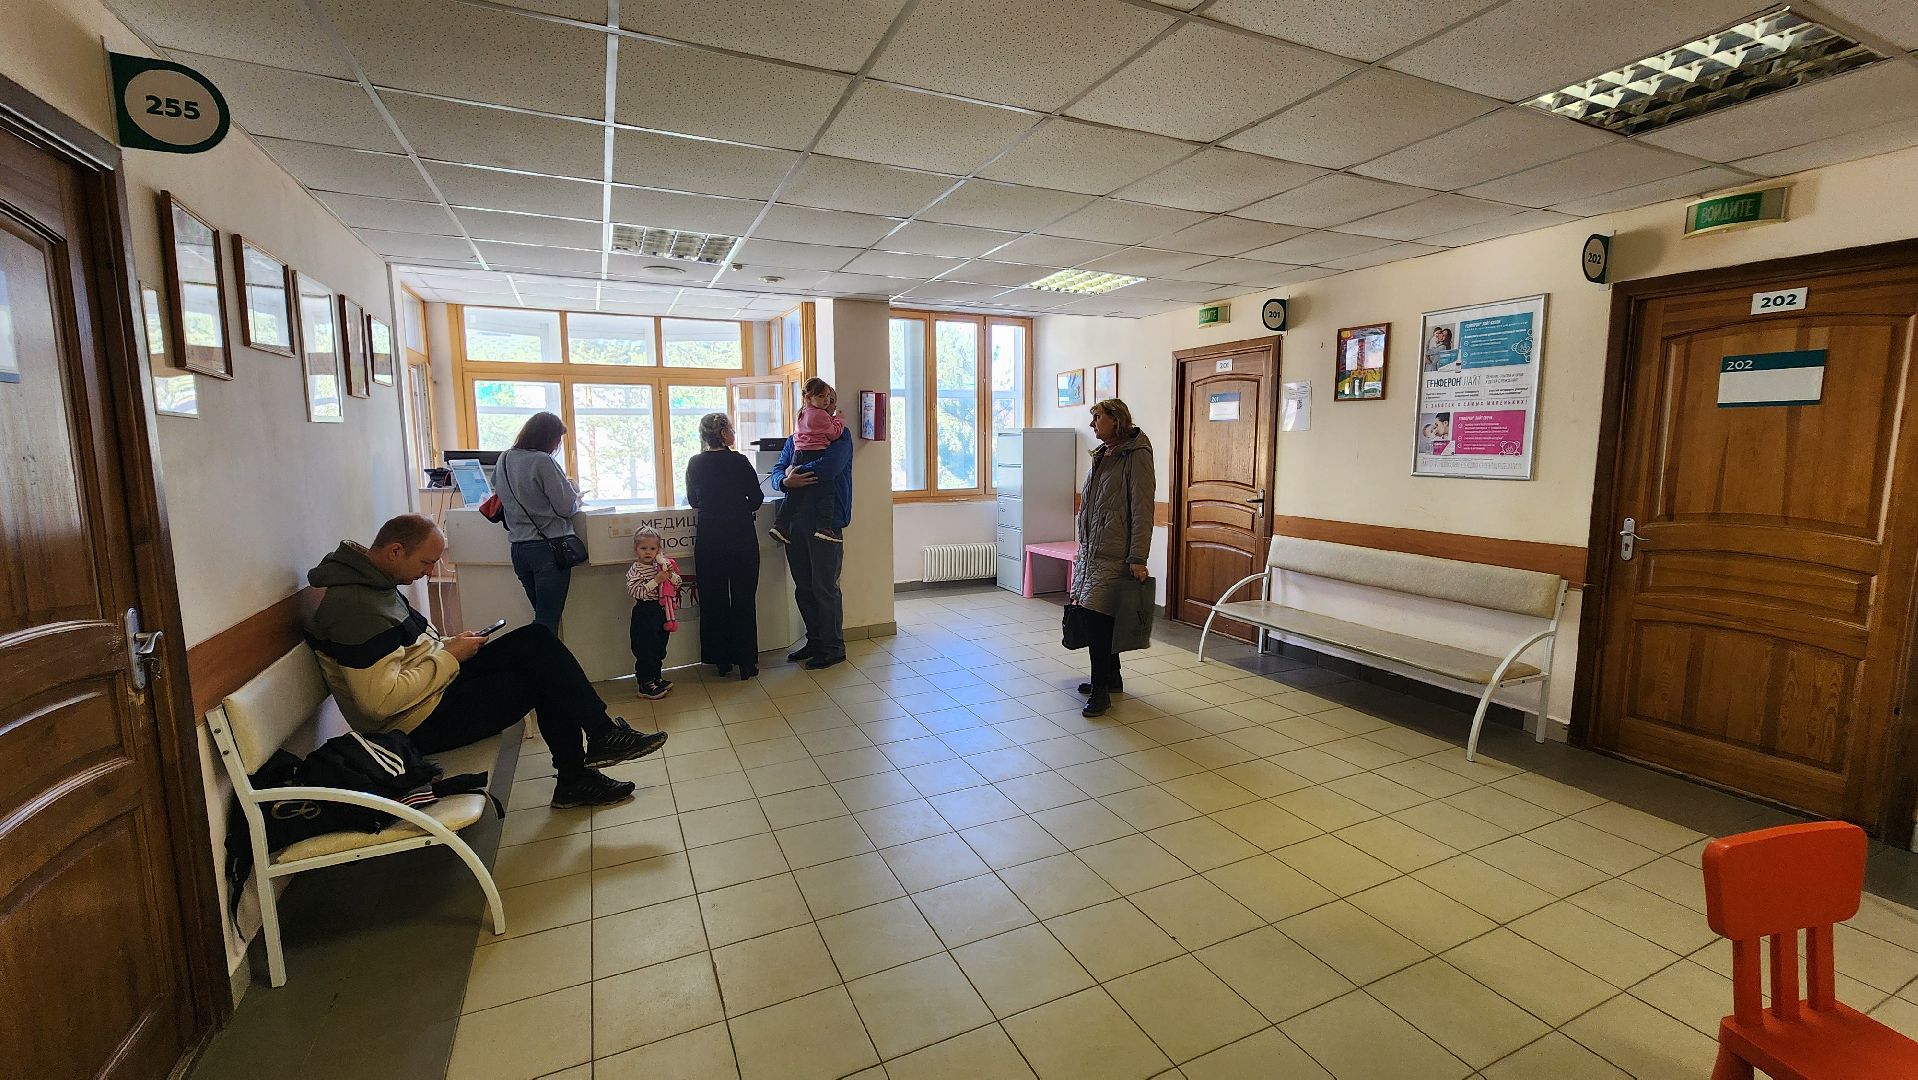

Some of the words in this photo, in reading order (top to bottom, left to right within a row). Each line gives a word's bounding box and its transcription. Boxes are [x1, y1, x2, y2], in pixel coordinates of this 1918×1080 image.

[145, 94, 201, 120] 255
[1587, 252, 1601, 265] 202
[1760, 293, 1798, 309] 202
[1268, 310, 1280, 319] 201
[1726, 359, 1753, 371] 202
[641, 516, 697, 531] МЕДИЦ
